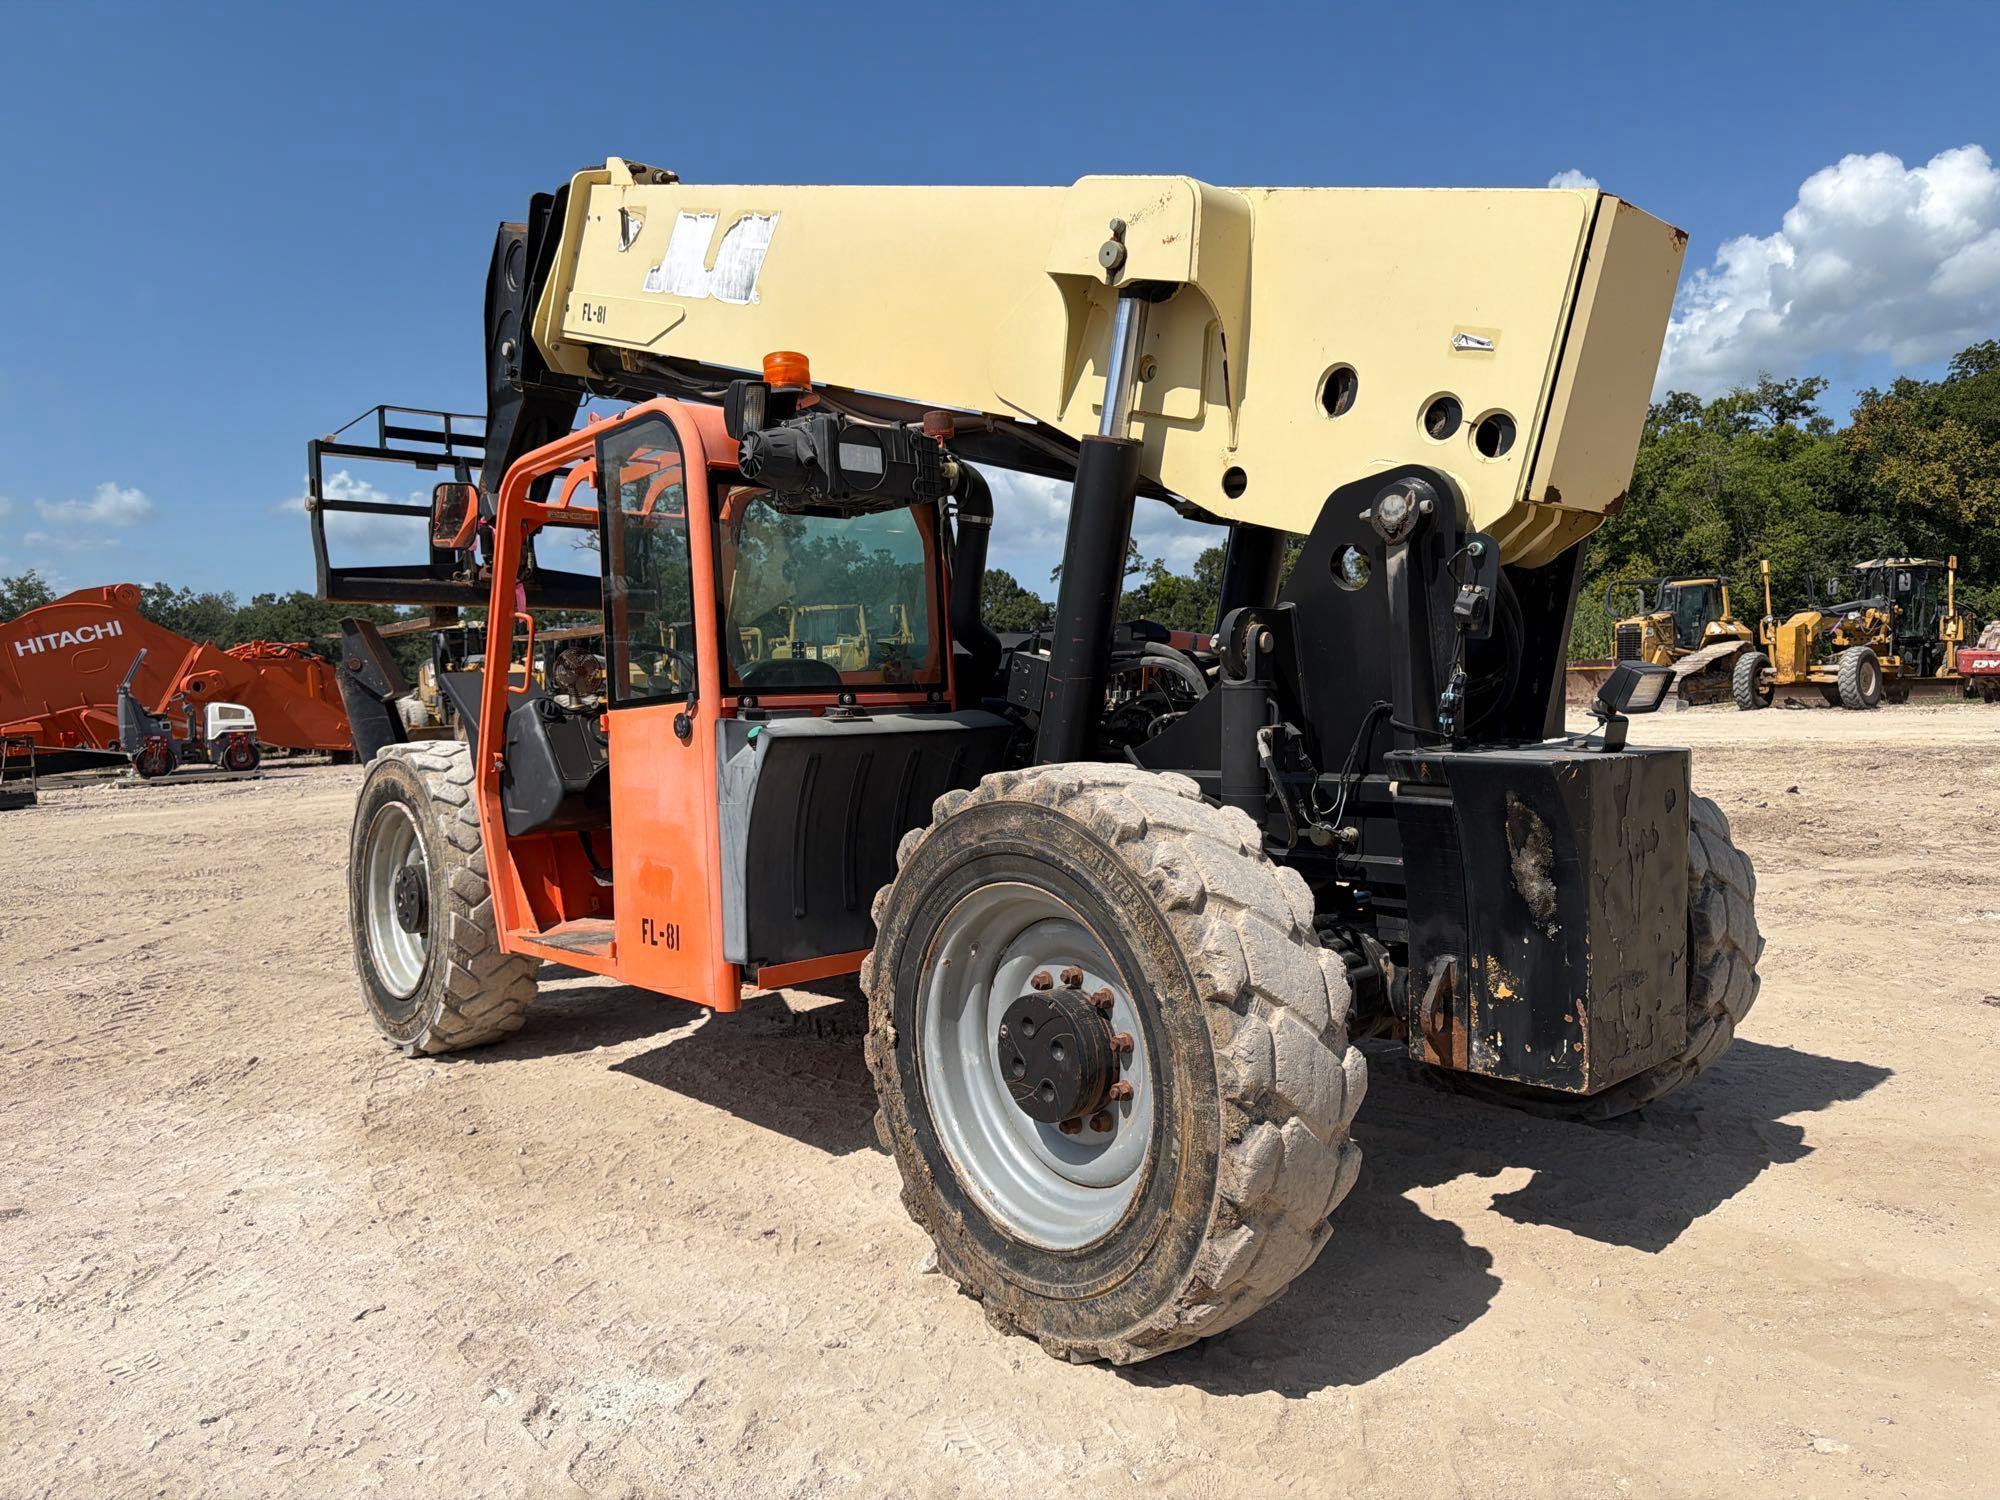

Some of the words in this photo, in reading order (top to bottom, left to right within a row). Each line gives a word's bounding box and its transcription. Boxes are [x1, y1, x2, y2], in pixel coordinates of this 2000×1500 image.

[582, 302, 607, 324] FL-81
[14, 620, 123, 657] HITACHI
[641, 917, 680, 951] FL-81
